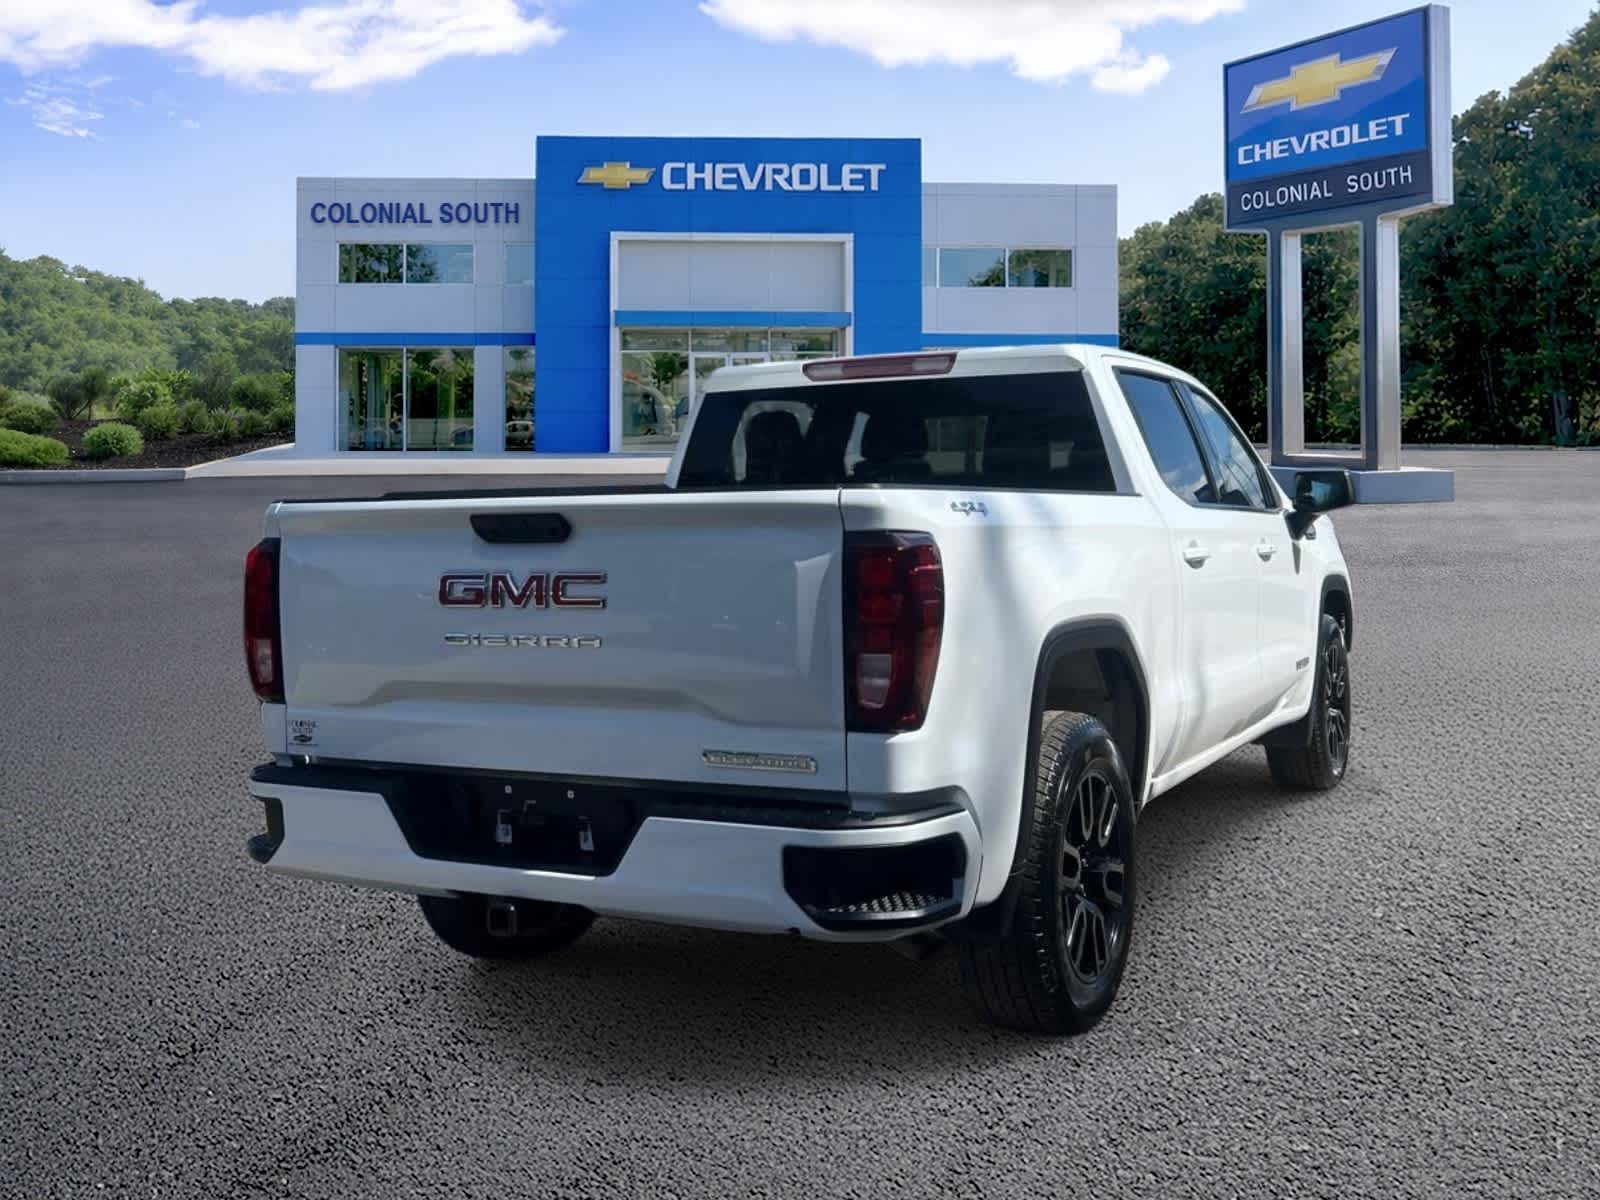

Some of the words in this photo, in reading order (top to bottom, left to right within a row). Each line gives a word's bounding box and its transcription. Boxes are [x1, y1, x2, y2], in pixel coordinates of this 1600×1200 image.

[1237, 113, 1410, 165] CHEVROLET
[661, 161, 887, 192] CHEVROLET
[1240, 180, 1333, 212] COLONIAL
[1346, 165, 1413, 194] SOUTH
[310, 202, 433, 225] COLONIAL
[439, 202, 520, 225] SOUTH
[438, 572, 608, 609] GMC
[443, 632, 603, 649] SIERRA
